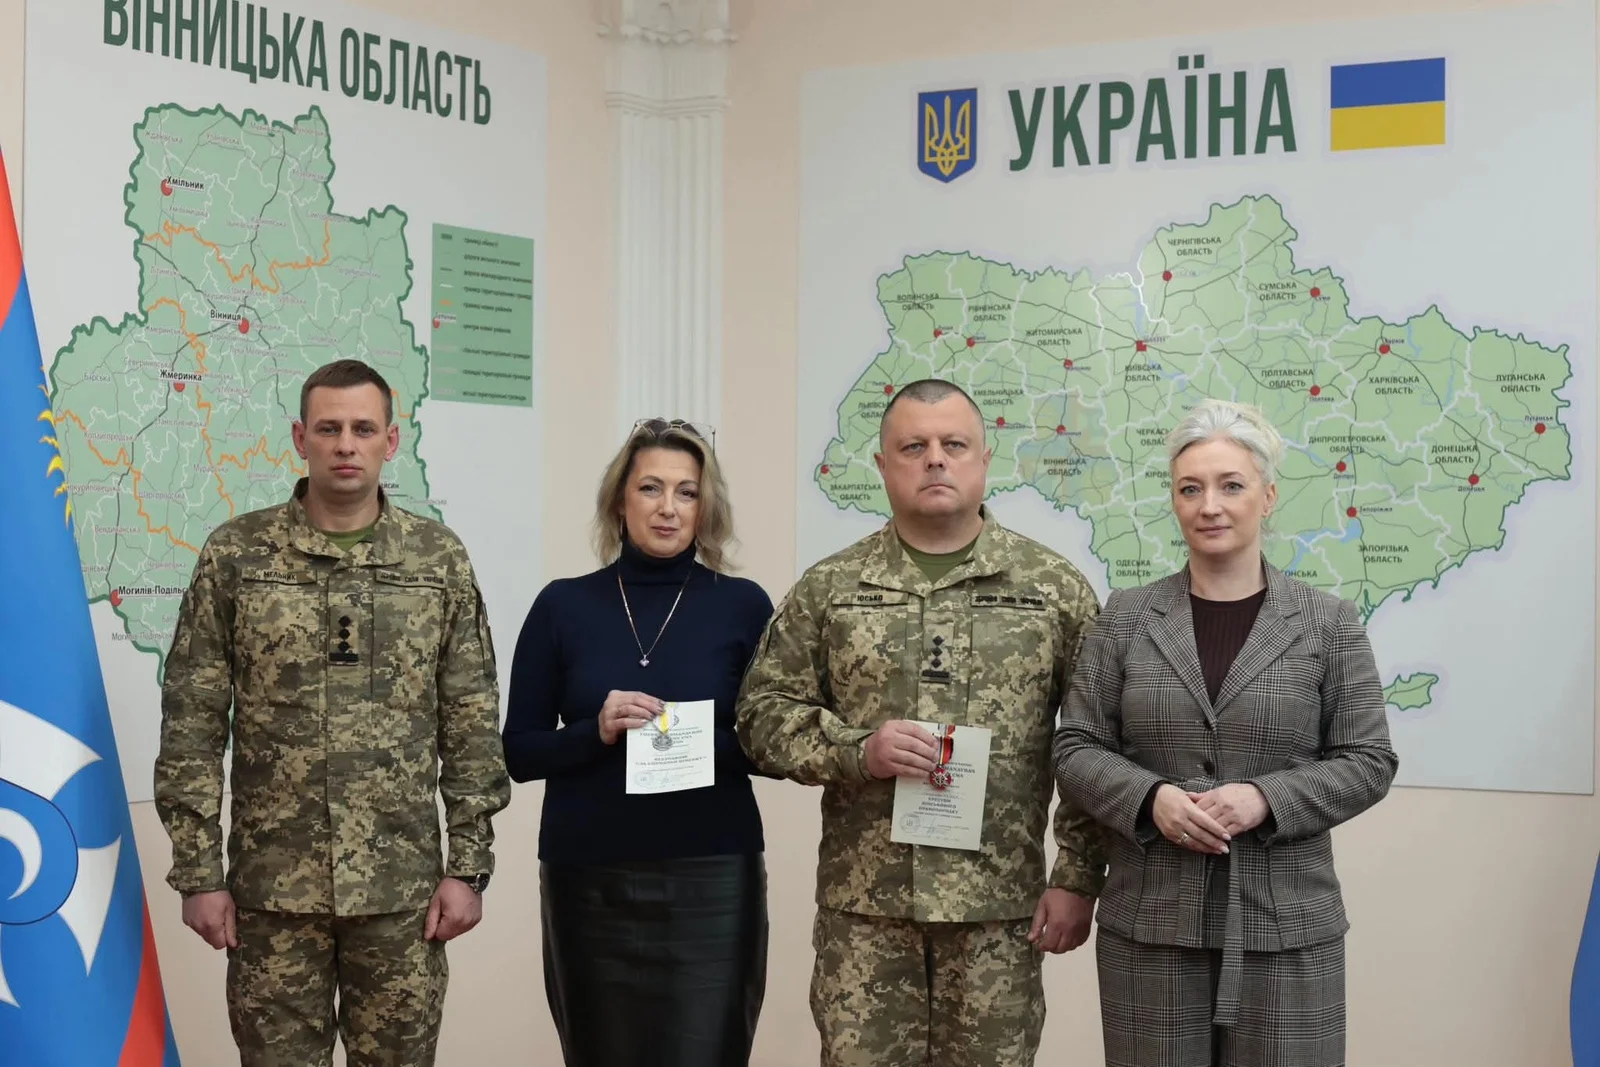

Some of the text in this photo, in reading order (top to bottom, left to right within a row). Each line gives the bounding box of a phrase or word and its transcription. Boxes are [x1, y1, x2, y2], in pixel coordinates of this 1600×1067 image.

[103, 0, 492, 125] ВІННИЦЬКА ОБЛАСТЬ
[1008, 54, 1298, 172] УКРАЇНА
[166, 175, 205, 190] Хмільник
[1168, 236, 1222, 246] ЧЕРНІГІВСЬКА
[1176, 248, 1213, 256] ОБЛАСТЬ
[1258, 282, 1297, 291] СУМСЬКА
[897, 293, 940, 301] ВОЛИНСЬКА
[1259, 292, 1297, 301] ОБЛАСТЬ
[902, 303, 935, 311] ОБЛАСТЬ
[968, 304, 1011, 313] РІВНЕНСЬКА
[210, 308, 242, 321] Вінниця
[973, 314, 1006, 322] ОБЛАСТЬ
[1025, 328, 1083, 336] ЖИТОМИРСЬКА
[1037, 338, 1071, 346] ОБЛАСТЬ
[159, 369, 202, 382] Жмеринка
[1261, 369, 1314, 377] ПОЛТАВСЬКА
[1368, 376, 1420, 384] ХАРКІВСЬКА
[1496, 373, 1546, 382] ЛУГАНСЬКА
[1269, 380, 1306, 388] ОБЛАСТЬ
[973, 389, 1024, 397] ХМЕЛЬНИЦЬКА
[1375, 387, 1413, 395] ОБЛАСТЬ
[1500, 385, 1541, 393] ОБЛАСТЬ
[858, 401, 888, 409] ЛЬВІВСЬ
[860, 411, 884, 419] ОБЛАС
[1136, 428, 1168, 436] ЧЕРКАС
[1308, 435, 1387, 443] ДНІПРОПЕТРОВСЬКА
[1329, 445, 1365, 453] ОБЛАСТЬ
[1431, 445, 1478, 454] ДОНЕЦЬКА
[1044, 458, 1087, 466] ВІННИЦЬКА
[1435, 455, 1475, 464] ОБЛАСТЬ
[1047, 468, 1082, 476] ОБЛАСТЬ
[839, 493, 871, 501] ОБЛАСТЬ
[1358, 545, 1410, 553] ЗАПОРІЗЬКА
[1115, 559, 1151, 568] ОДЕСЬКА
[1364, 556, 1403, 564] ОБЛАСТЬ
[263, 571, 297, 581] МЕЛЬНИК
[1284, 570, 1318, 578] ОНСЬКА
[118, 585, 189, 596] Могилів-Подільс
